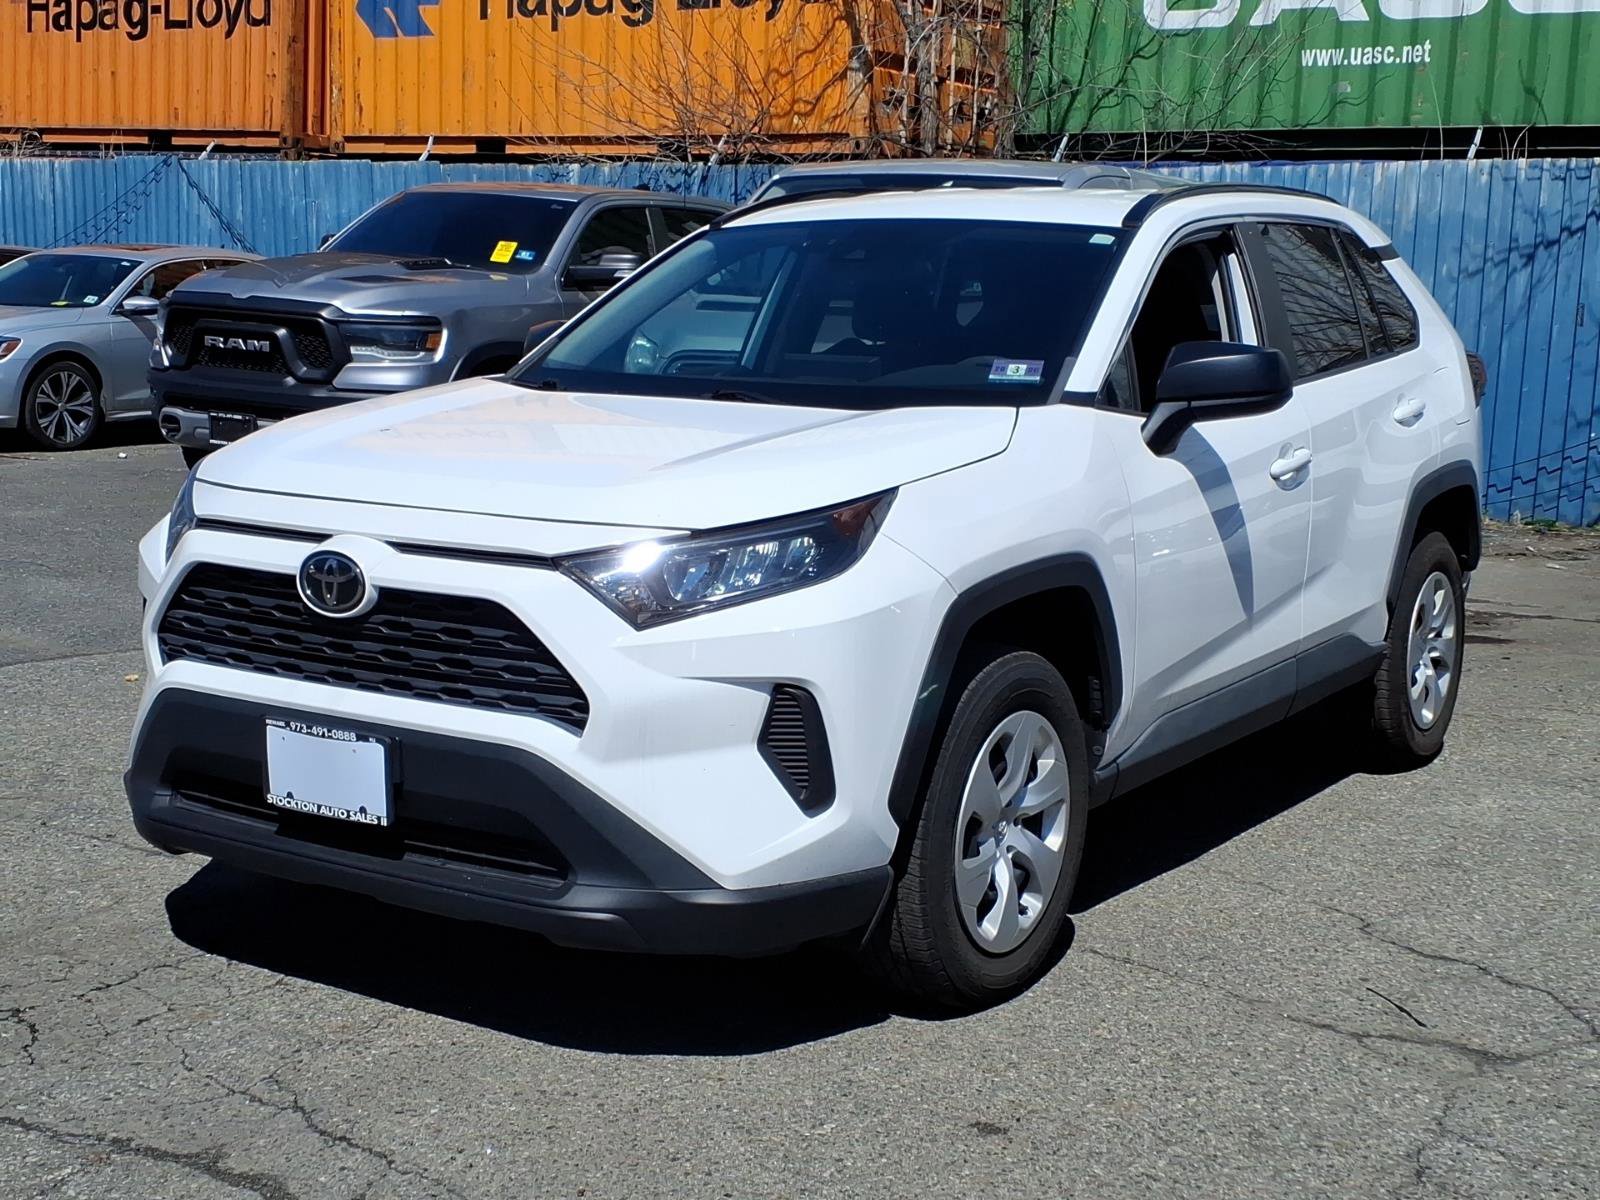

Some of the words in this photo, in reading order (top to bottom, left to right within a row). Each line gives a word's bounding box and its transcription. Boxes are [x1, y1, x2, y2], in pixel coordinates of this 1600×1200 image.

[1301, 39, 1431, 67] www.uasc.net
[204, 335, 270, 352] RAM
[1012, 366, 1020, 374] 3
[290, 721, 357, 742] 973-491-0888
[267, 793, 318, 813] STOCKTON
[319, 804, 347, 819] AUTO
[350, 811, 378, 825] SALES
